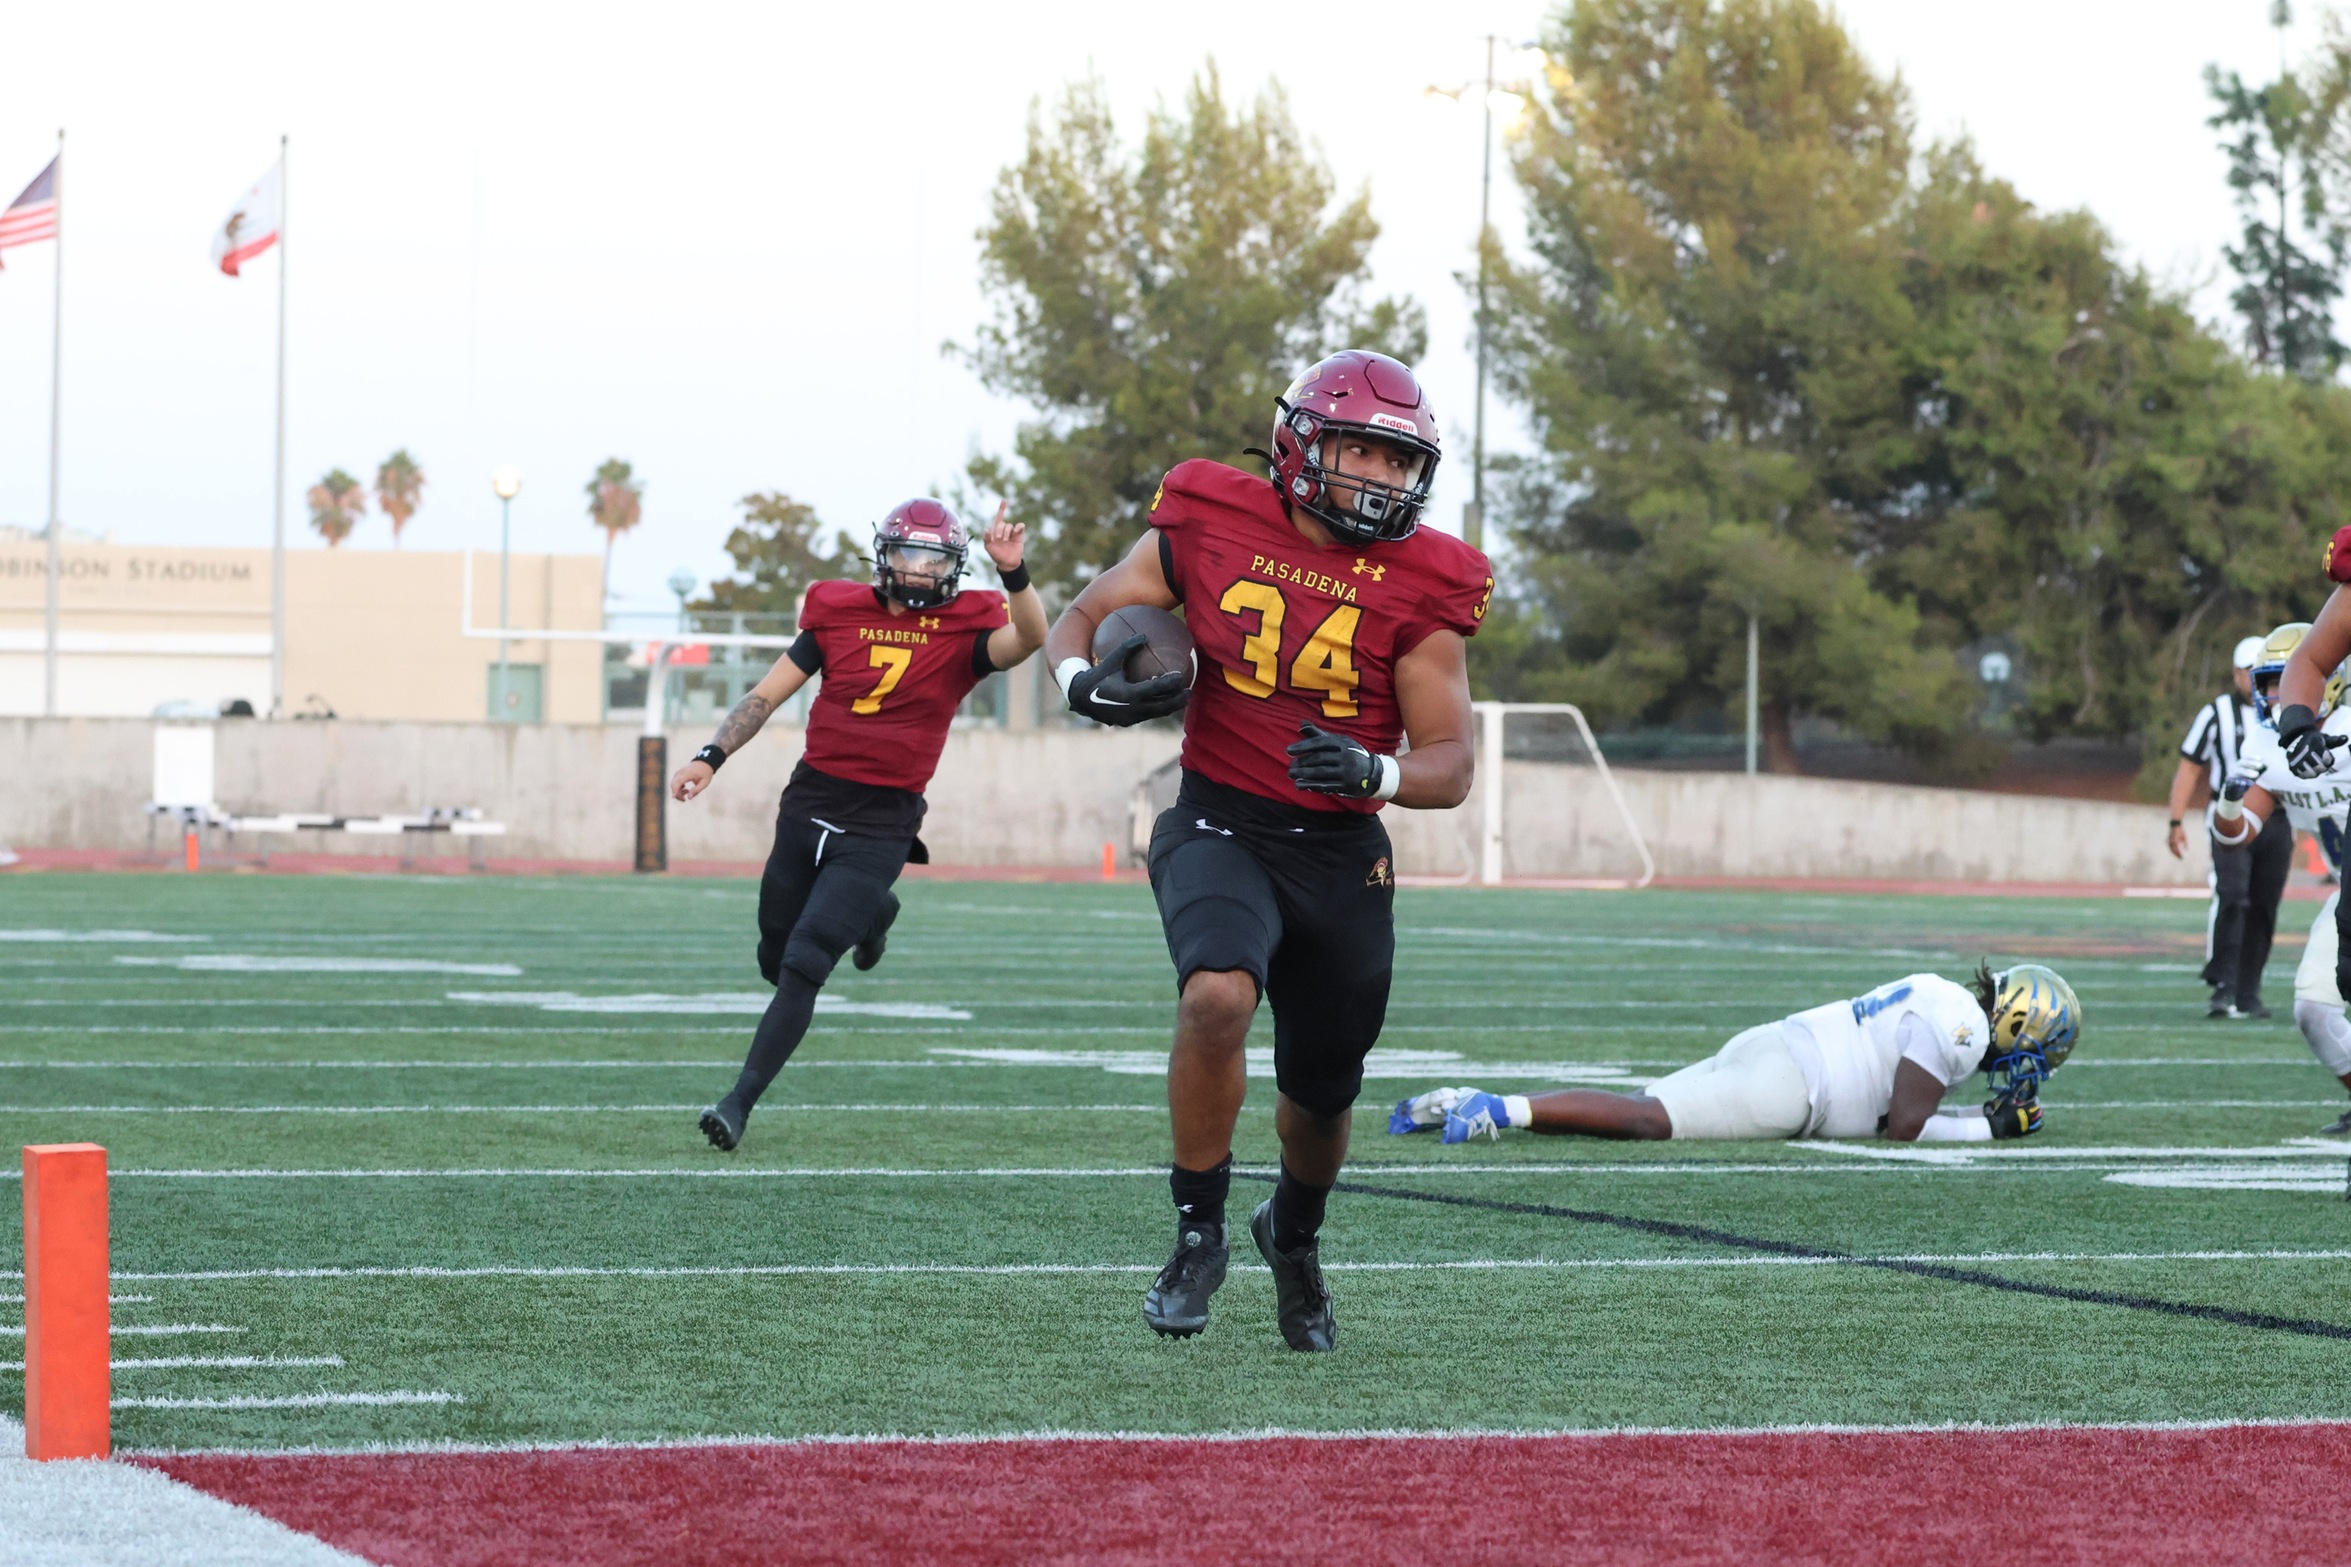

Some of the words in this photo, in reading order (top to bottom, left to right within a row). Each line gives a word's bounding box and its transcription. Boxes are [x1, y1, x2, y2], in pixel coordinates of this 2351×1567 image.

[1378, 417, 1414, 432] Riddell
[0, 557, 110, 579] BINSON
[128, 557, 251, 581] STADIUM
[1250, 555, 1358, 602] PASADENA
[1472, 576, 1495, 620] 3
[859, 627, 928, 645] PASADENA
[1219, 577, 1363, 719] 34
[851, 644, 913, 715] 7
